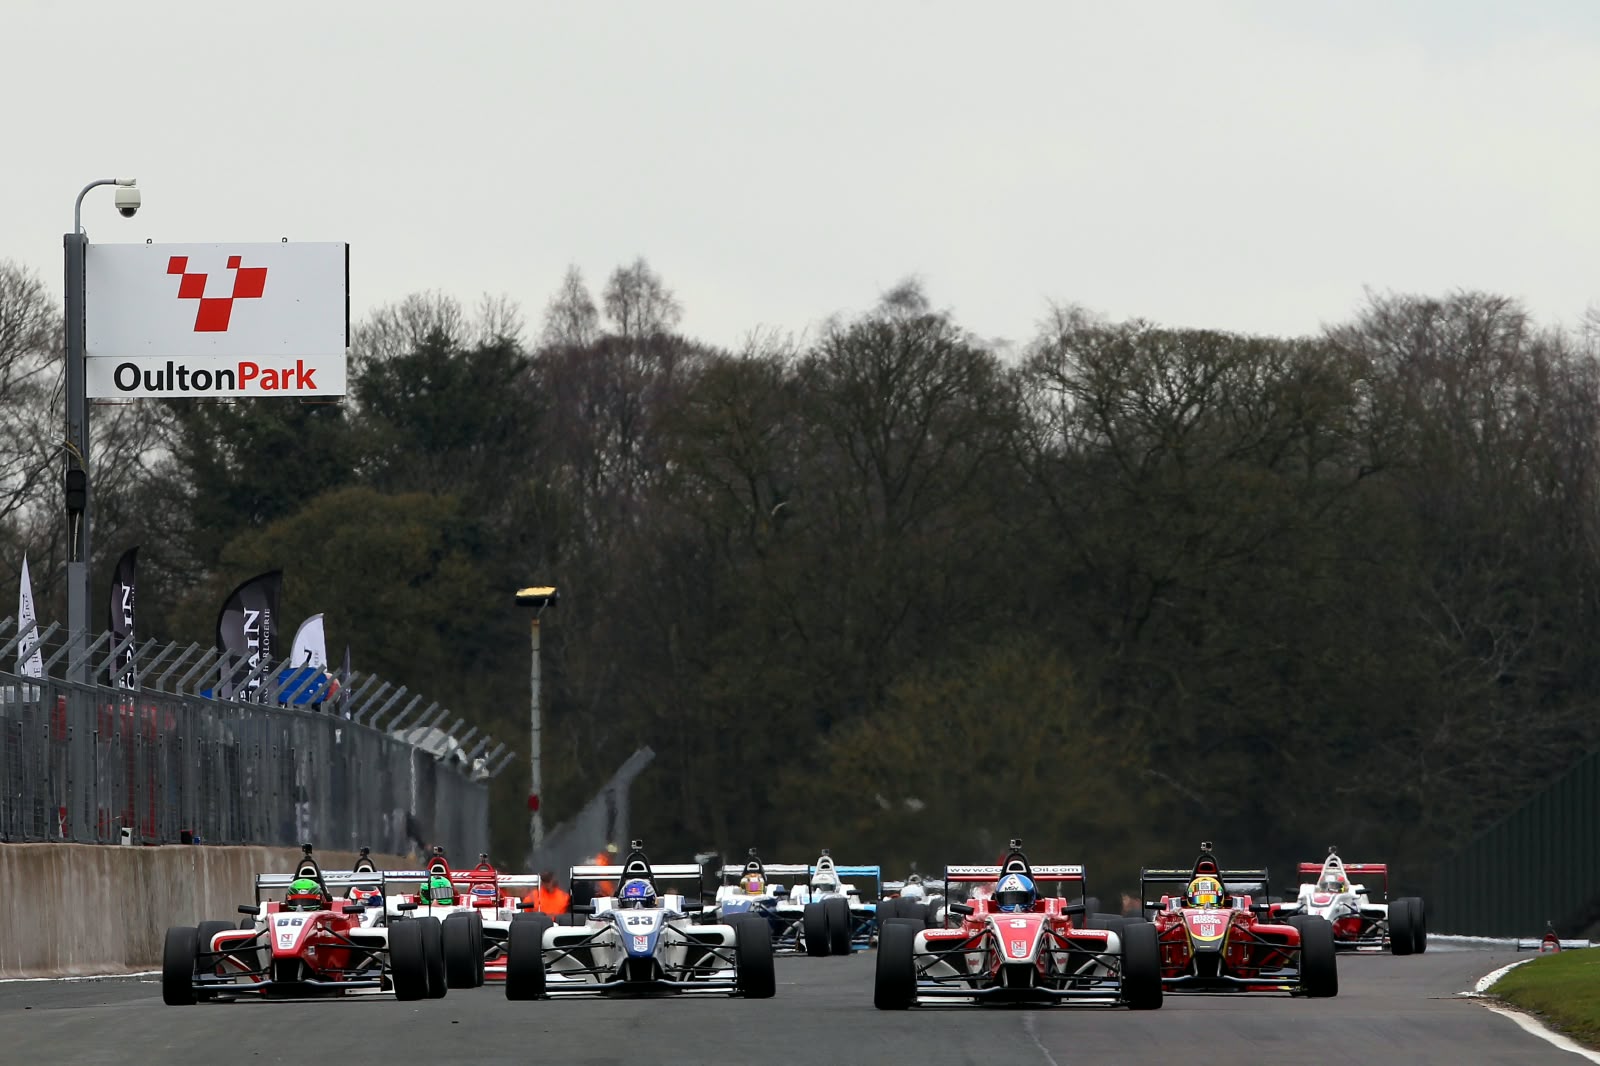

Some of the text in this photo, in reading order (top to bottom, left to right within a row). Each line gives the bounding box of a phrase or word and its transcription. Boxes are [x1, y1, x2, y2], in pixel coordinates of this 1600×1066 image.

[113, 359, 318, 392] OultonPark
[277, 918, 304, 926] 66
[627, 916, 653, 926] 33
[1009, 918, 1027, 929] 3
